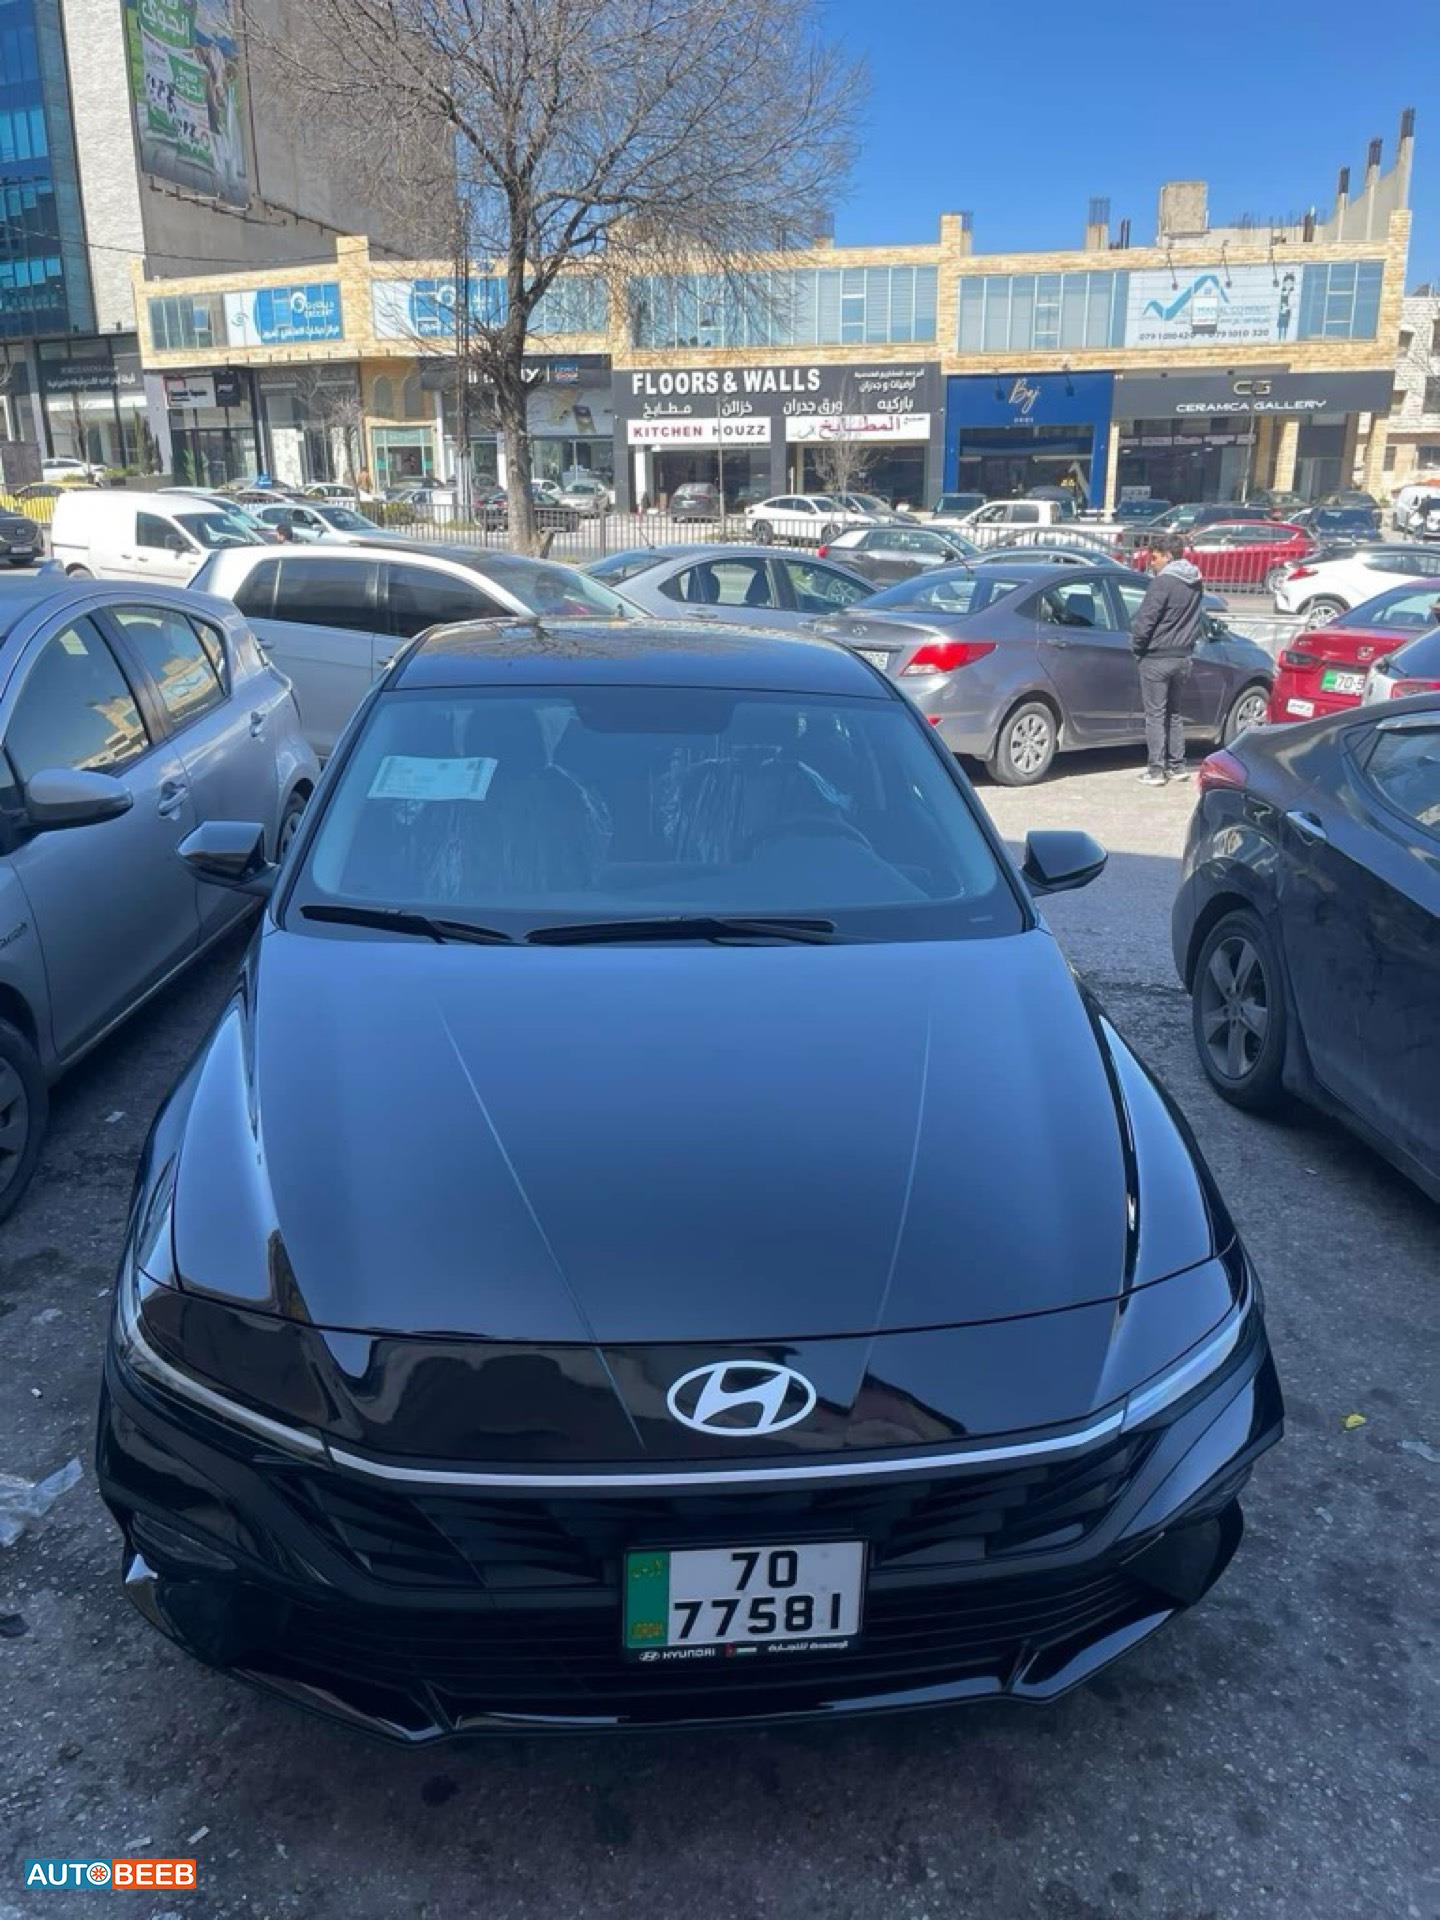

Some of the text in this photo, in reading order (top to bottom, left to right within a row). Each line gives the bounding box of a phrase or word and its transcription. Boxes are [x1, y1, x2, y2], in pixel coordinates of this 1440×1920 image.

[631, 368, 821, 395] FLOORS & WALLS
[642, 402, 693, 419] مطابخ
[783, 398, 817, 414] جدران
[1253, 400, 1327, 410] GALLERY
[633, 425, 766, 437] KITCHEN HOUZZ
[731, 1550, 798, 1591] 70
[674, 1593, 841, 1640] 77581
[661, 1648, 716, 1660] HYUNDAI
